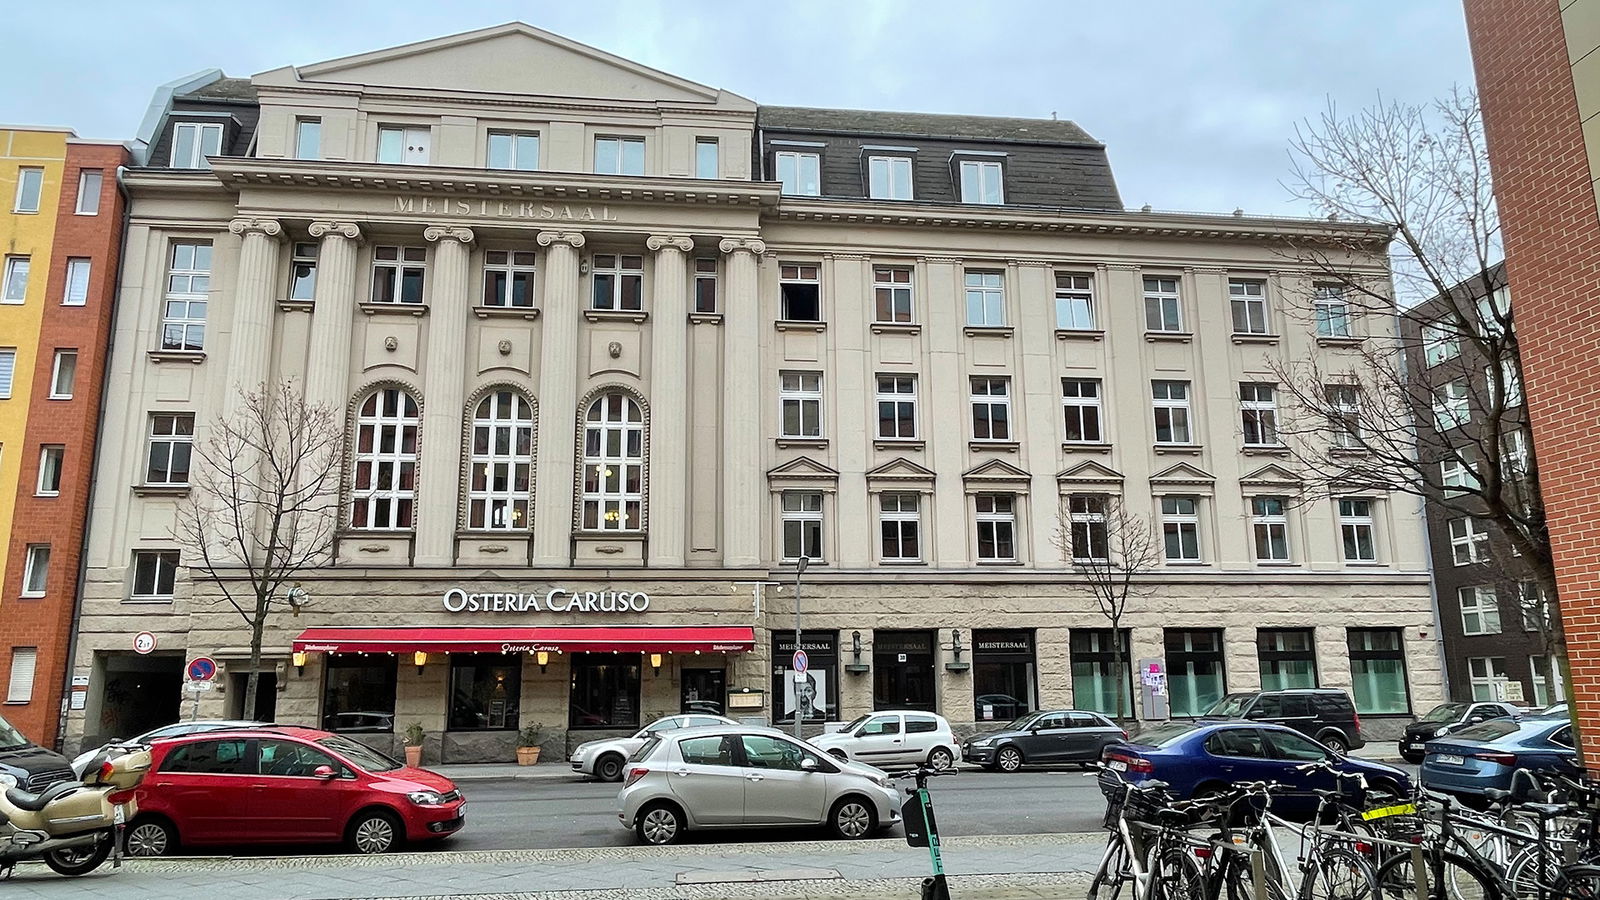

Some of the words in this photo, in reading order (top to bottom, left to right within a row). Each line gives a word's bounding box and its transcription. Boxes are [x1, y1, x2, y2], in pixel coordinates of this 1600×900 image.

[393, 196, 617, 222] MEISTERSAAL
[501, 643, 531, 652] Osteria
[532, 643, 560, 652] Caruso
